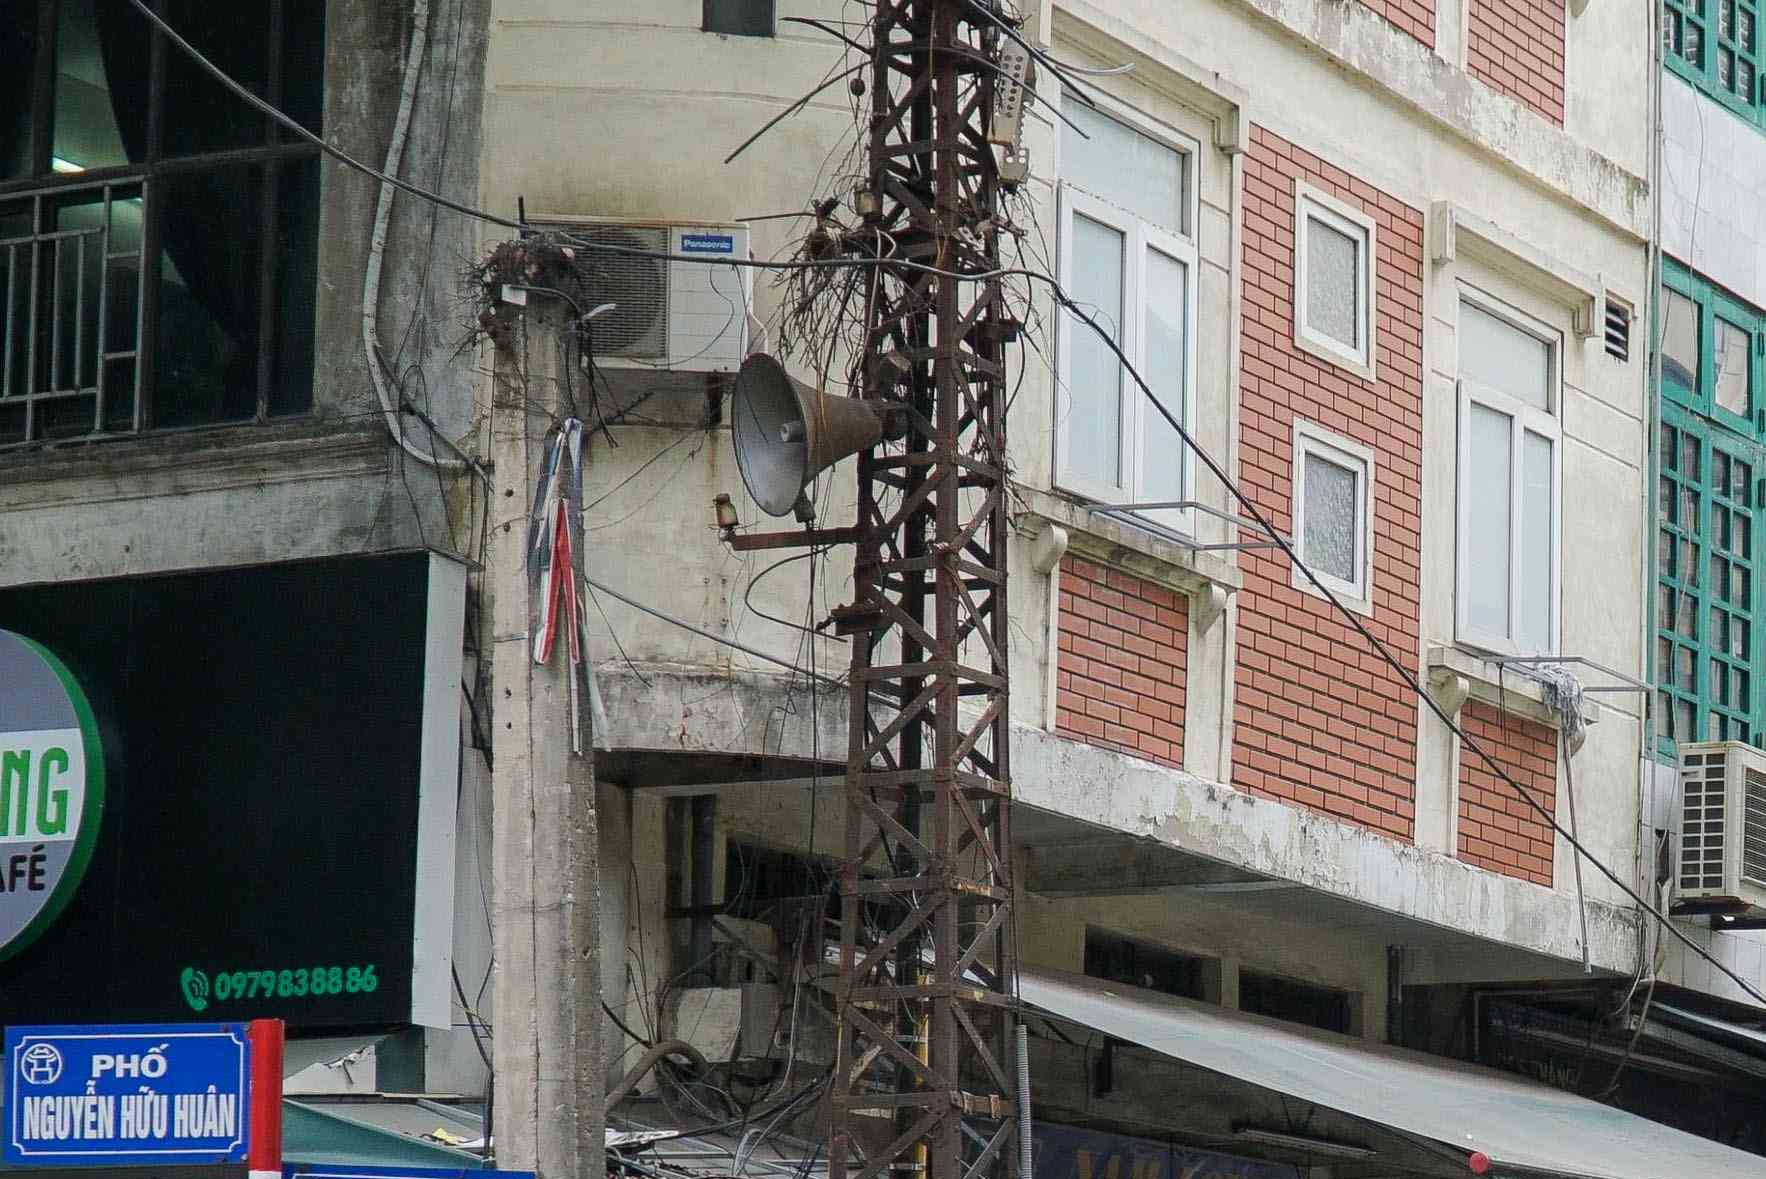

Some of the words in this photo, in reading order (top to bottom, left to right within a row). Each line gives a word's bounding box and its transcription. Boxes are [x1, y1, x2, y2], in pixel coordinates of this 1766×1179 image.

[214, 964, 378, 1001] 0979838886
[91, 1043, 170, 1079] PHỐ
[23, 1080, 115, 1139] NGUYỄN
[120, 1085, 168, 1139] HỮU
[174, 1084, 236, 1138] HUÂN
